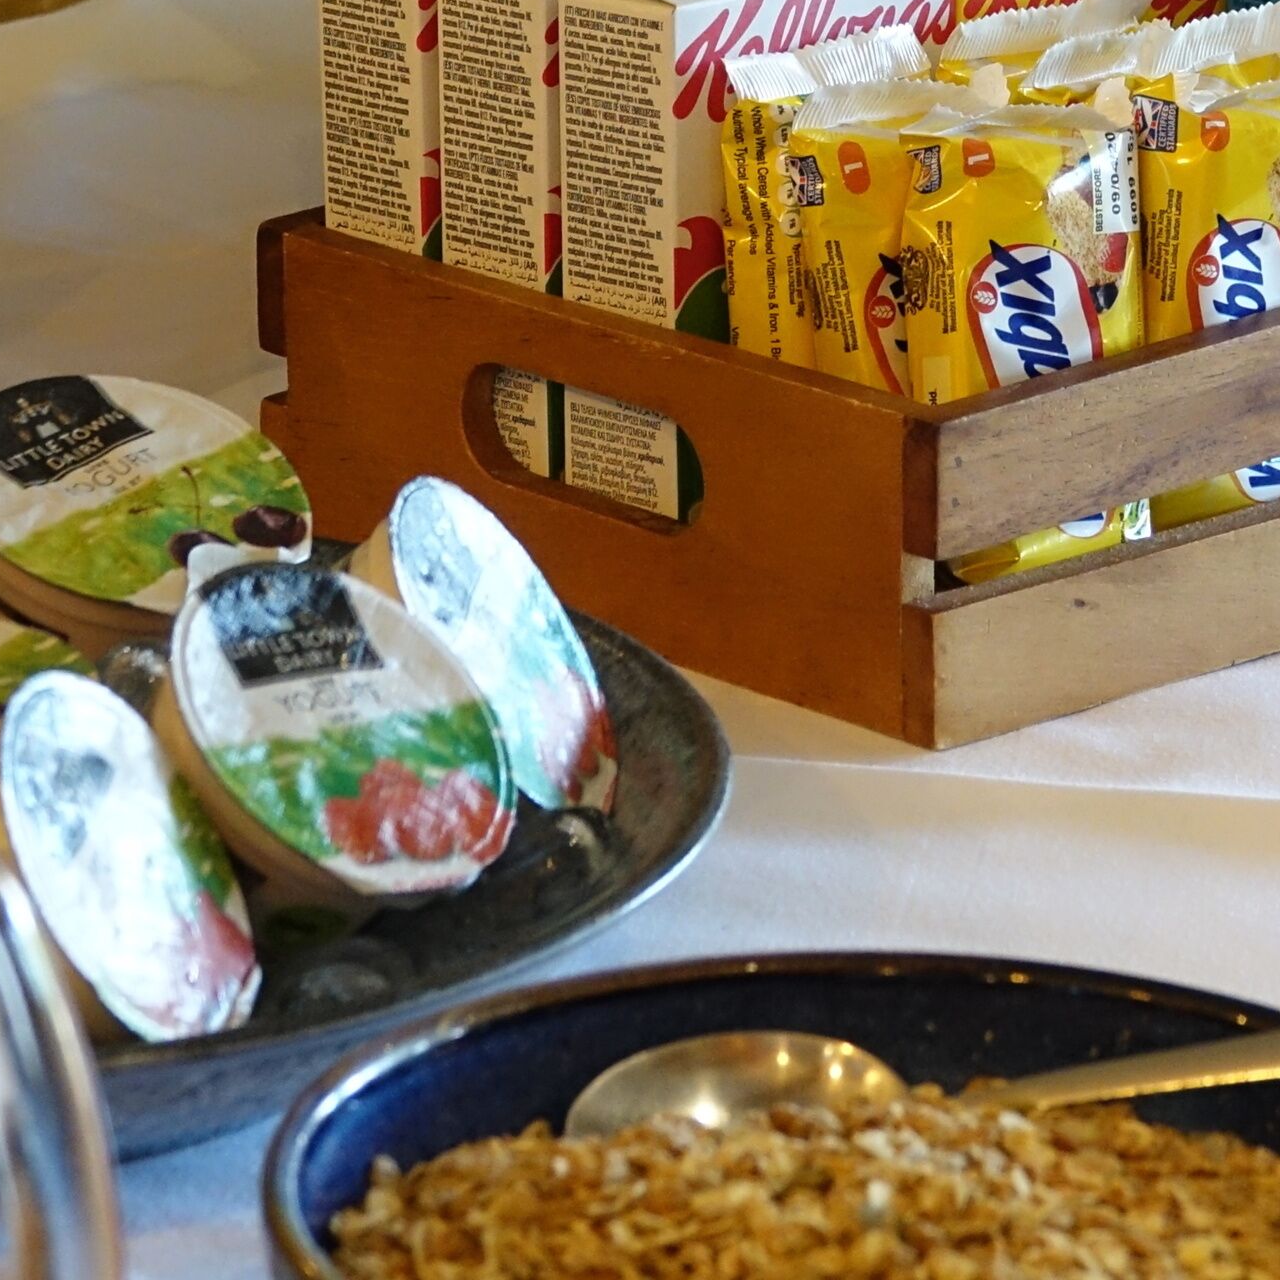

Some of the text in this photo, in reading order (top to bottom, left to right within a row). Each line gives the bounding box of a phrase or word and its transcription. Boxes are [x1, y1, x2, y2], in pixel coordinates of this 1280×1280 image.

[1158, 104, 1169, 148] CERTIFIED
[1166, 103, 1177, 151] STANDARDS
[1205, 120, 1226, 129] 1
[733, 147, 750, 180] Typical
[843, 161, 863, 174] 1
[967, 152, 990, 166] 1
[756, 167, 770, 200] Cereal
[738, 183, 754, 221] average
[760, 200, 772, 221] with
[1094, 206, 1103, 232] BEST
[748, 222, 759, 256] values
[764, 222, 776, 255] Added
[766, 257, 777, 300] Vitamins
[768, 302, 779, 311] &
[769, 312, 779, 335] Iron.
[63, 409, 126, 445] TOWN
[45, 435, 106, 471] DAIRY
[63, 447, 158, 496] OGURT
